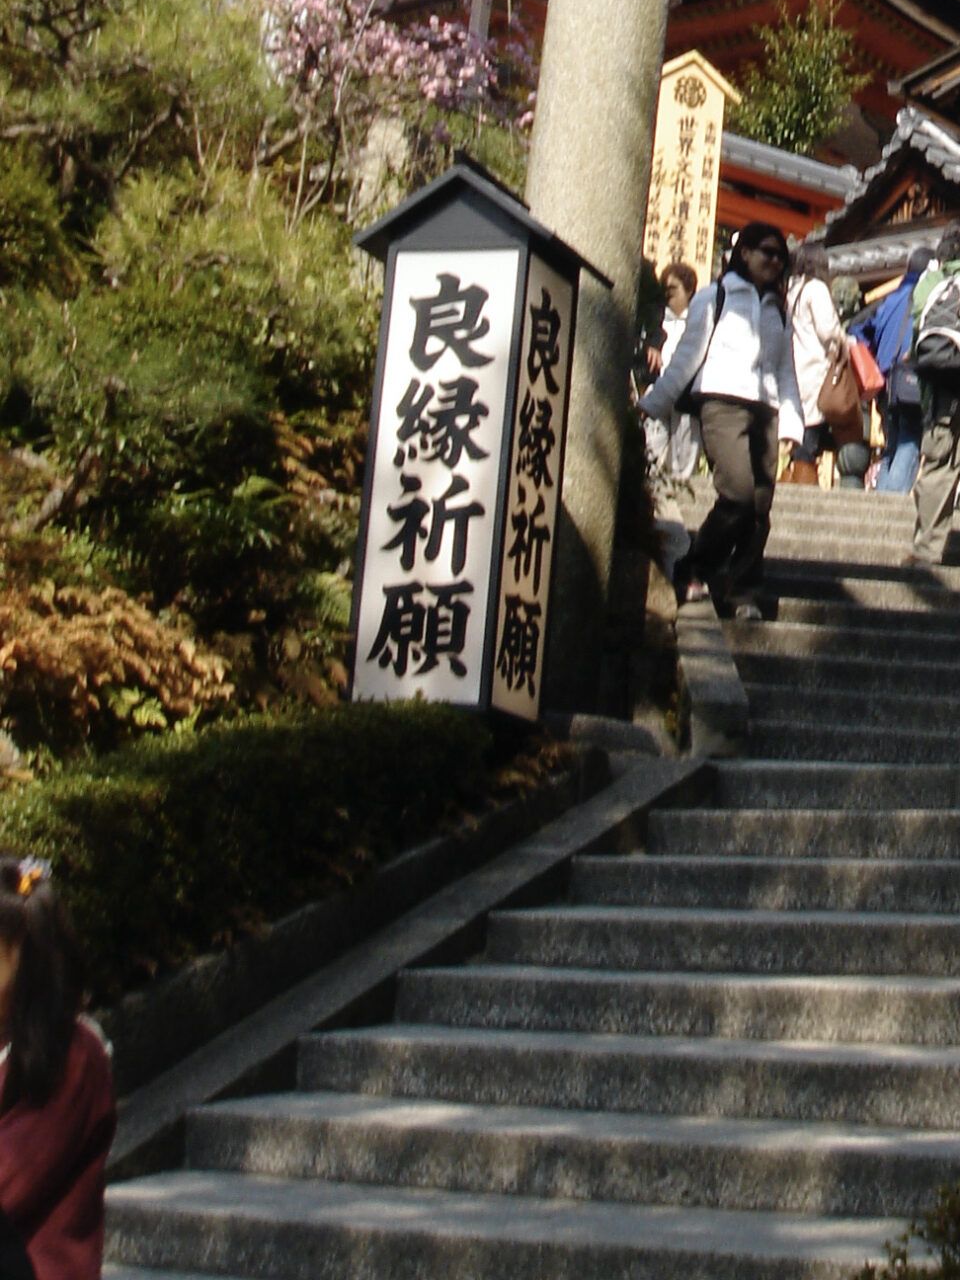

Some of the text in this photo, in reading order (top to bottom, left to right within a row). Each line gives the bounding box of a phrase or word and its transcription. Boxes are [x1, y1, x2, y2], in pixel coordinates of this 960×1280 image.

[365, 271, 495, 678] 良縁祈願
[496, 287, 562, 698] 良縁祈願
